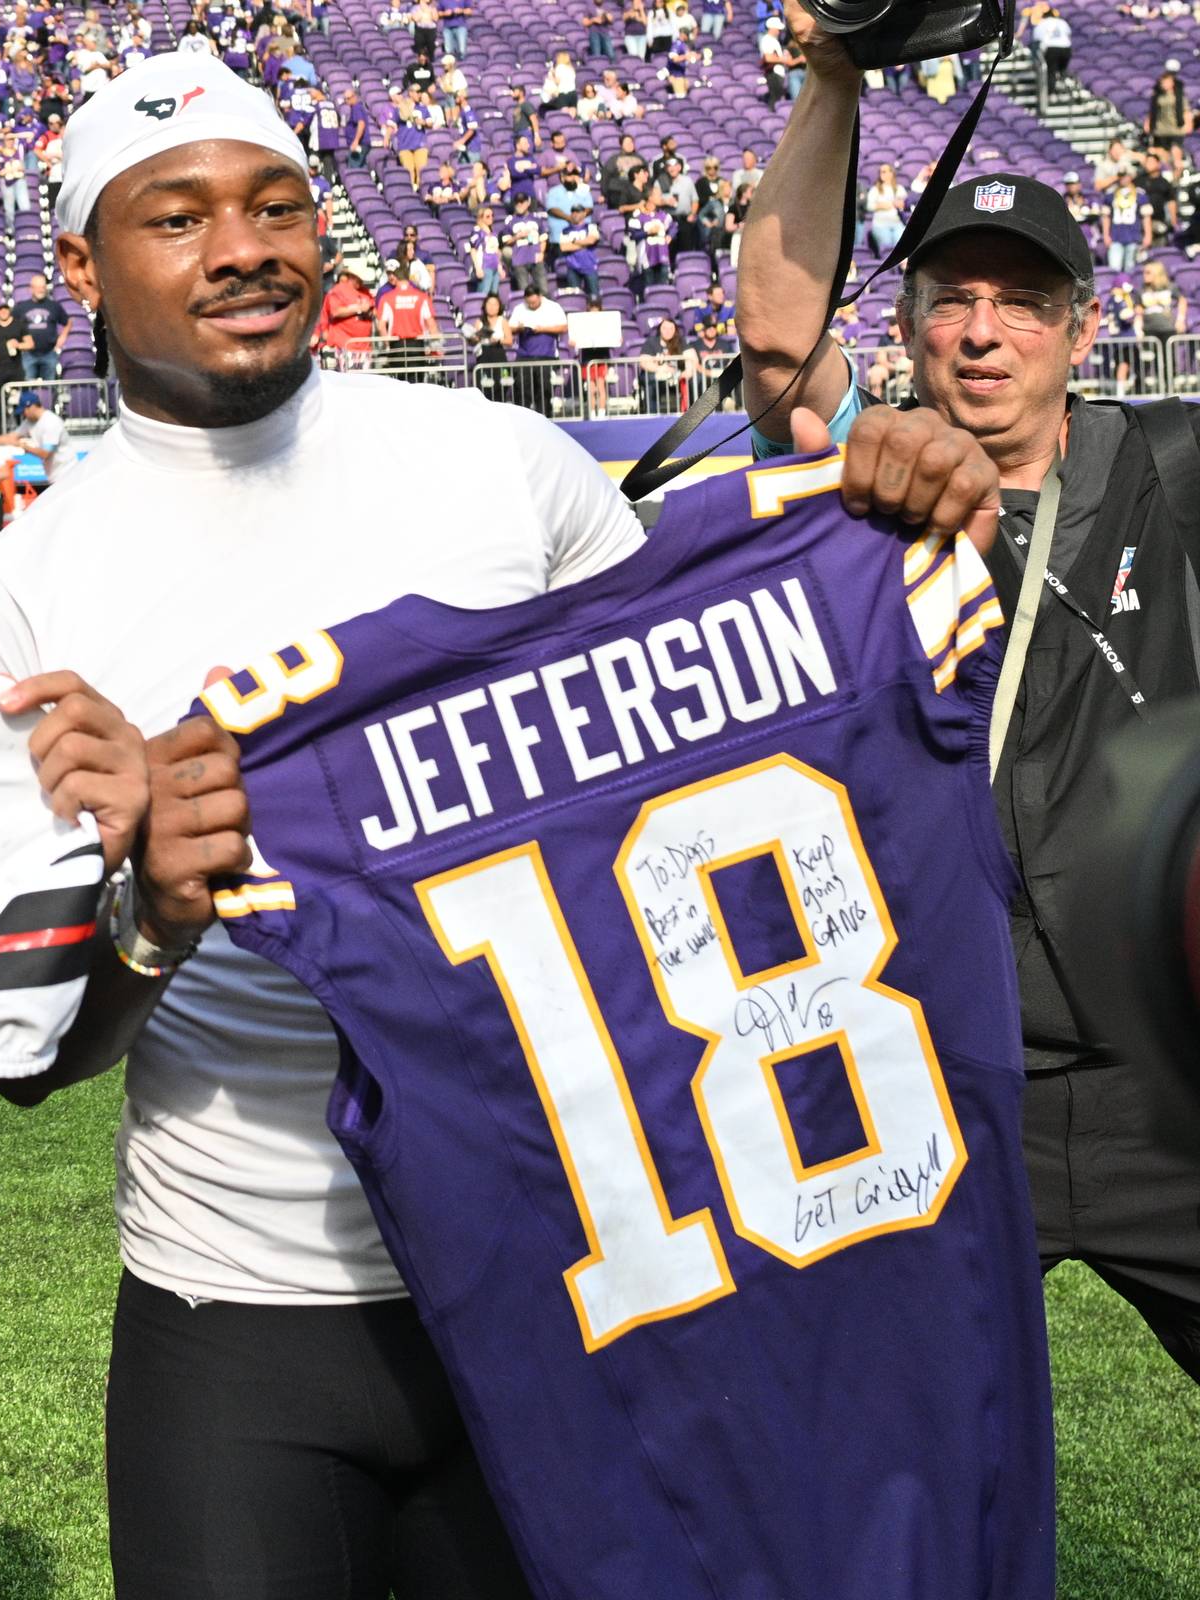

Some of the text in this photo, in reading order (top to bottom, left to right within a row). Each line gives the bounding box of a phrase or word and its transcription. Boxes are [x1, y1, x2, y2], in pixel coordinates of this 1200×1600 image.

[979, 195, 1008, 208] NFL
[1044, 567, 1069, 596] SON
[1112, 588, 1141, 616] DIA
[1092, 632, 1125, 674] SONY
[360, 577, 838, 851] JEFFERSON
[812, 900, 867, 948] GANG
[413, 752, 969, 1354] 18
